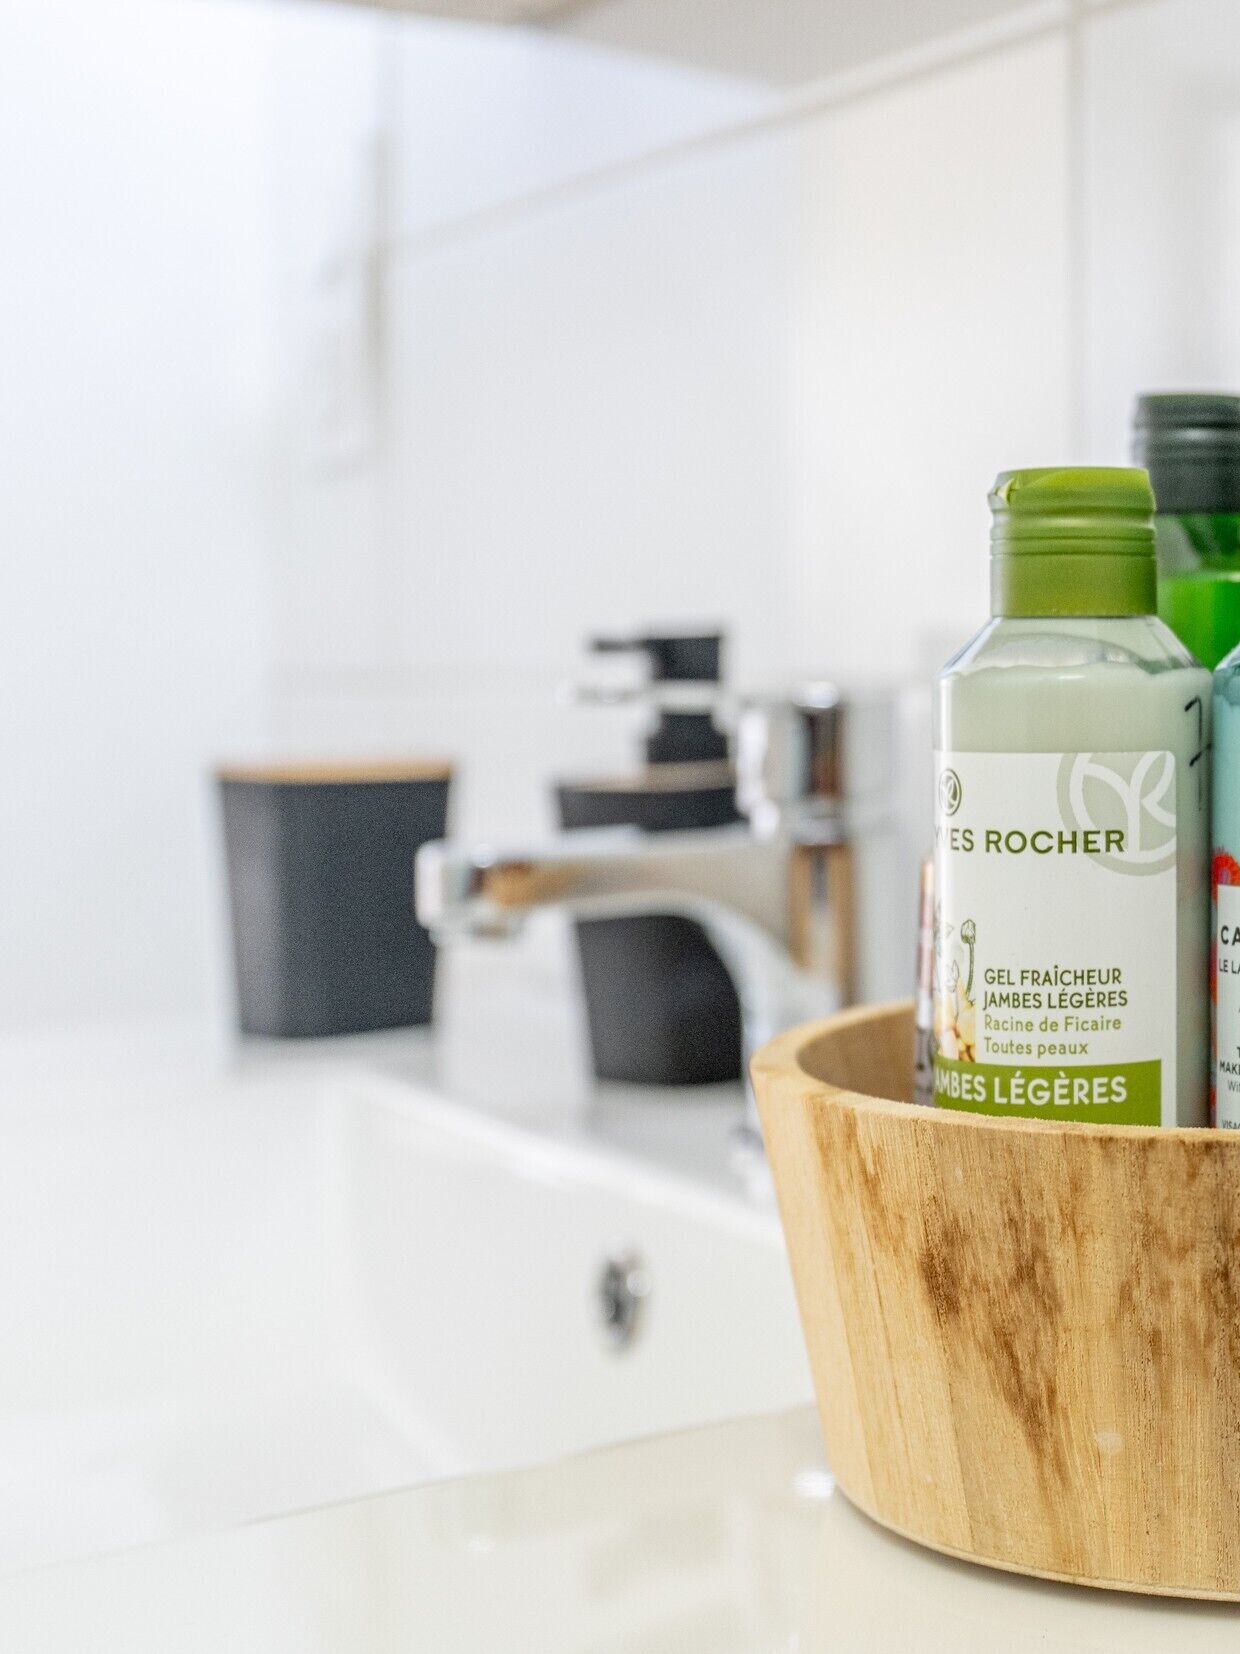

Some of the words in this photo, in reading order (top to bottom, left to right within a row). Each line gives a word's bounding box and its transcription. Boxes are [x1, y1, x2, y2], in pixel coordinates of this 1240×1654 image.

[985, 829, 1125, 853] ROCHER
[984, 968, 1015, 986] GEL
[1019, 965, 1122, 987] FRAÎCHEUR
[982, 990, 1043, 1011] JAMBES
[1047, 987, 1129, 1009] LÉGÈRES
[984, 1014, 1034, 1032] Racine
[1038, 1016, 1059, 1032] de
[1064, 1015, 1122, 1032] Ficaire
[984, 1036, 1033, 1055] Toutes
[1036, 1040, 1089, 1059] peaux
[934, 1066, 987, 1102] AMBES
[993, 1070, 1128, 1106] LÉGÈRES
